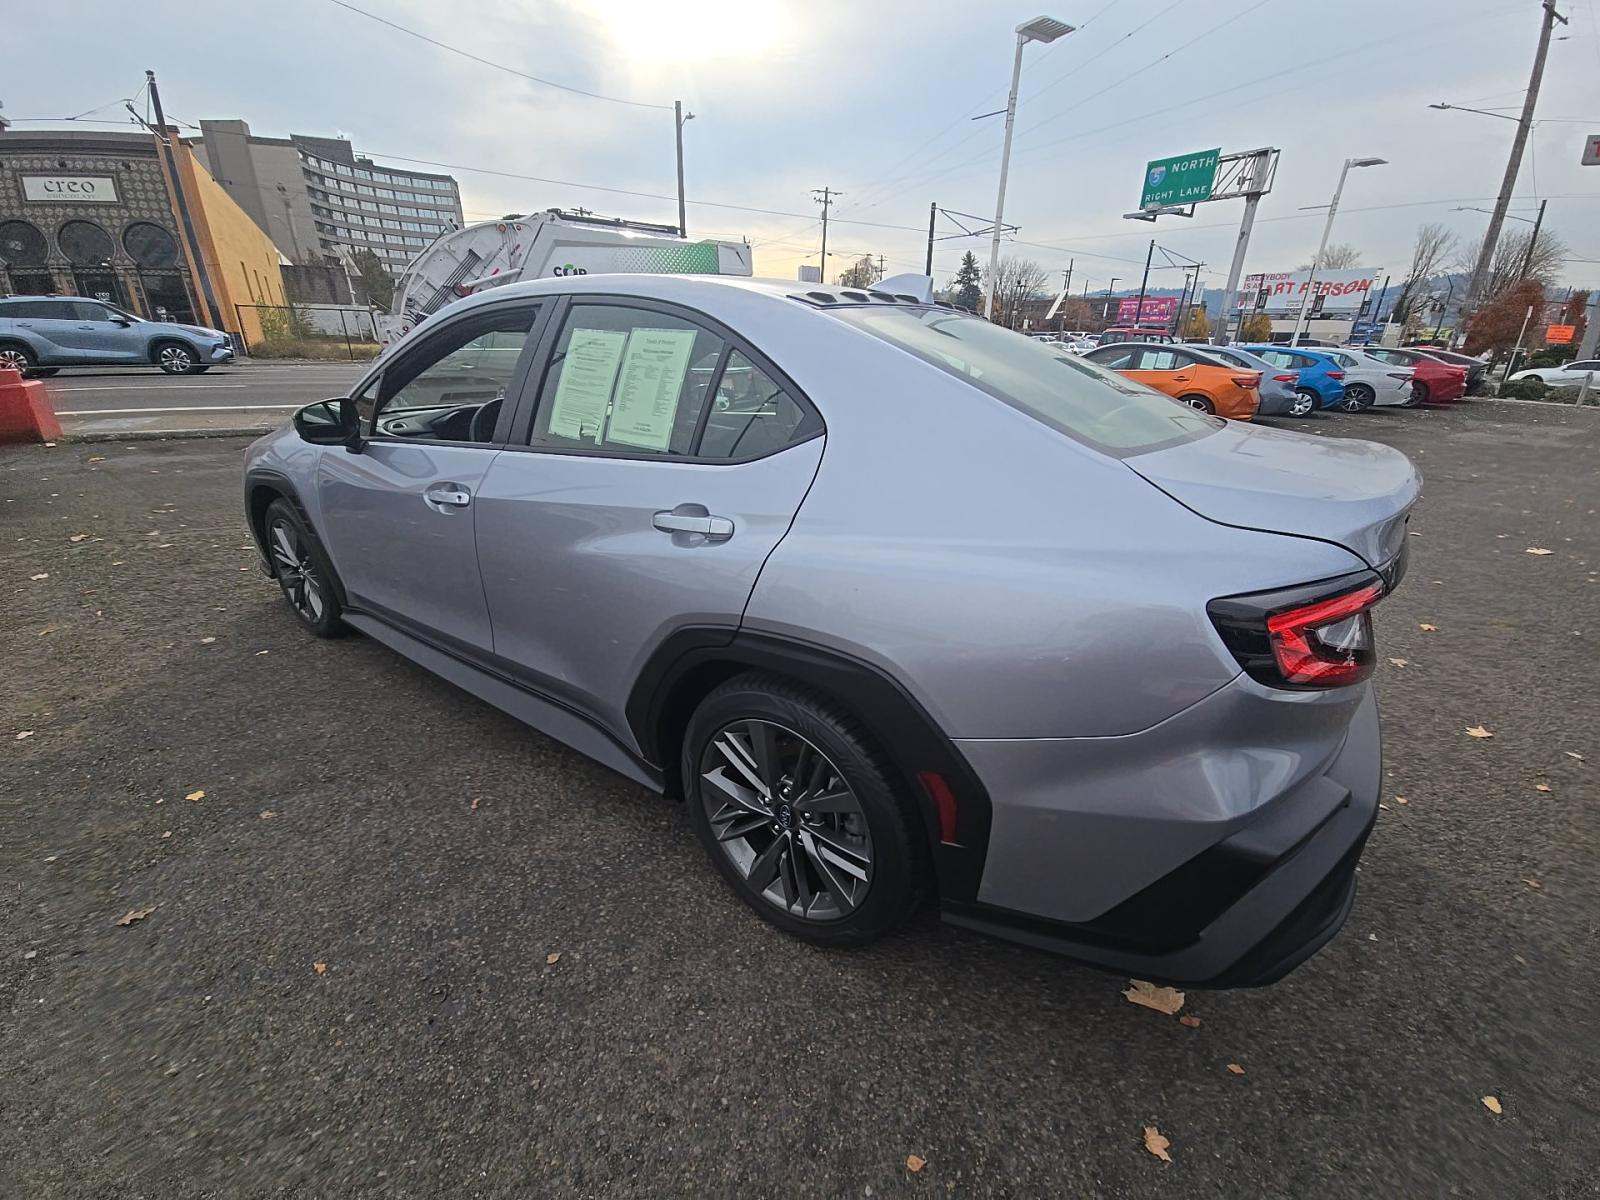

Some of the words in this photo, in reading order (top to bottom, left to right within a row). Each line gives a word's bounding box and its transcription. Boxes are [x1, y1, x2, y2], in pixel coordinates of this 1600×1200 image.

[1172, 157, 1214, 172] NORTH
[44, 181, 95, 193] creo
[1145, 191, 1173, 201] RIGHT
[1180, 186, 1207, 196] LANE
[1263, 281, 1296, 296] ART
[1299, 279, 1372, 296] PERSON
